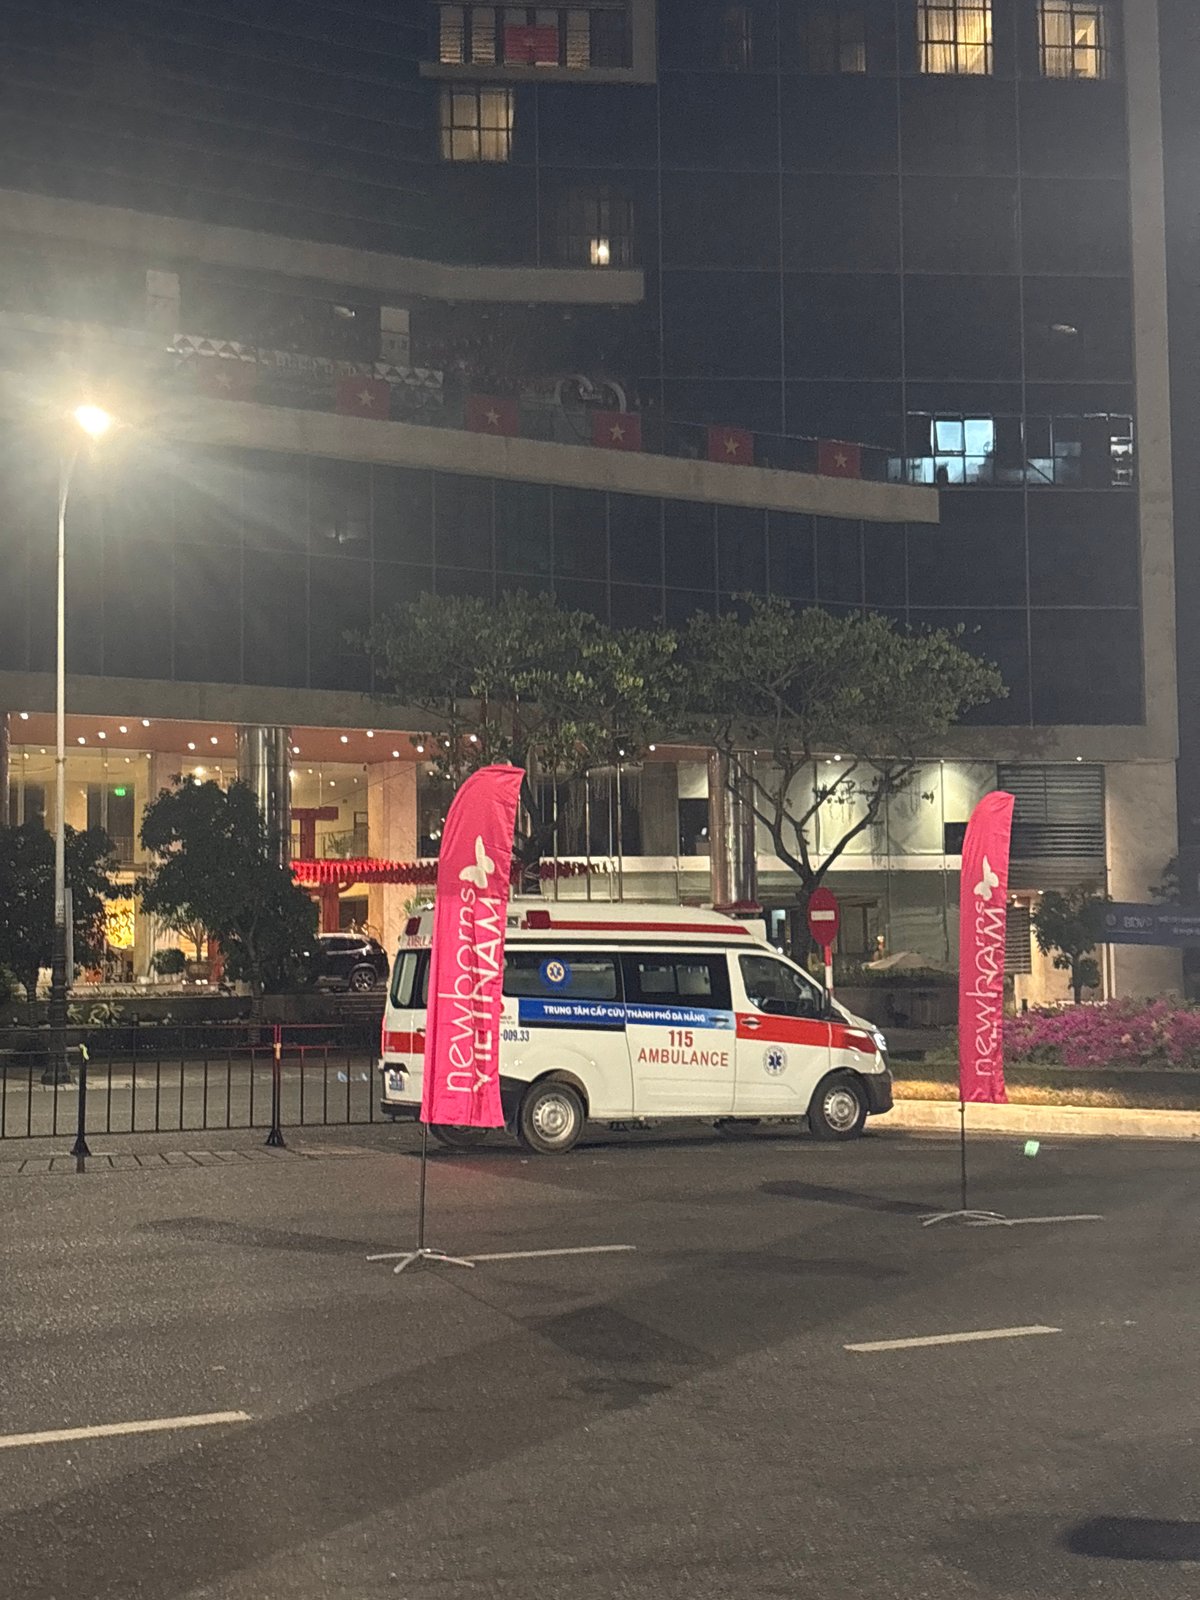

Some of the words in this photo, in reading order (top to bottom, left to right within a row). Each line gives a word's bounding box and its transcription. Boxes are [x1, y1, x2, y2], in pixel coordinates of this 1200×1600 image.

[437, 887, 476, 1093] newborns
[543, 1005, 571, 1015] TRUNG
[573, 1005, 589, 1016] TÂM
[590, 1005, 606, 1017] CẤP
[626, 1008, 654, 1019] THÀNH
[655, 1008, 671, 1020] PHỐ
[672, 1010, 684, 1021] ĐÀ
[668, 1029, 693, 1048] 115
[637, 1047, 729, 1067] AMBULANCE
